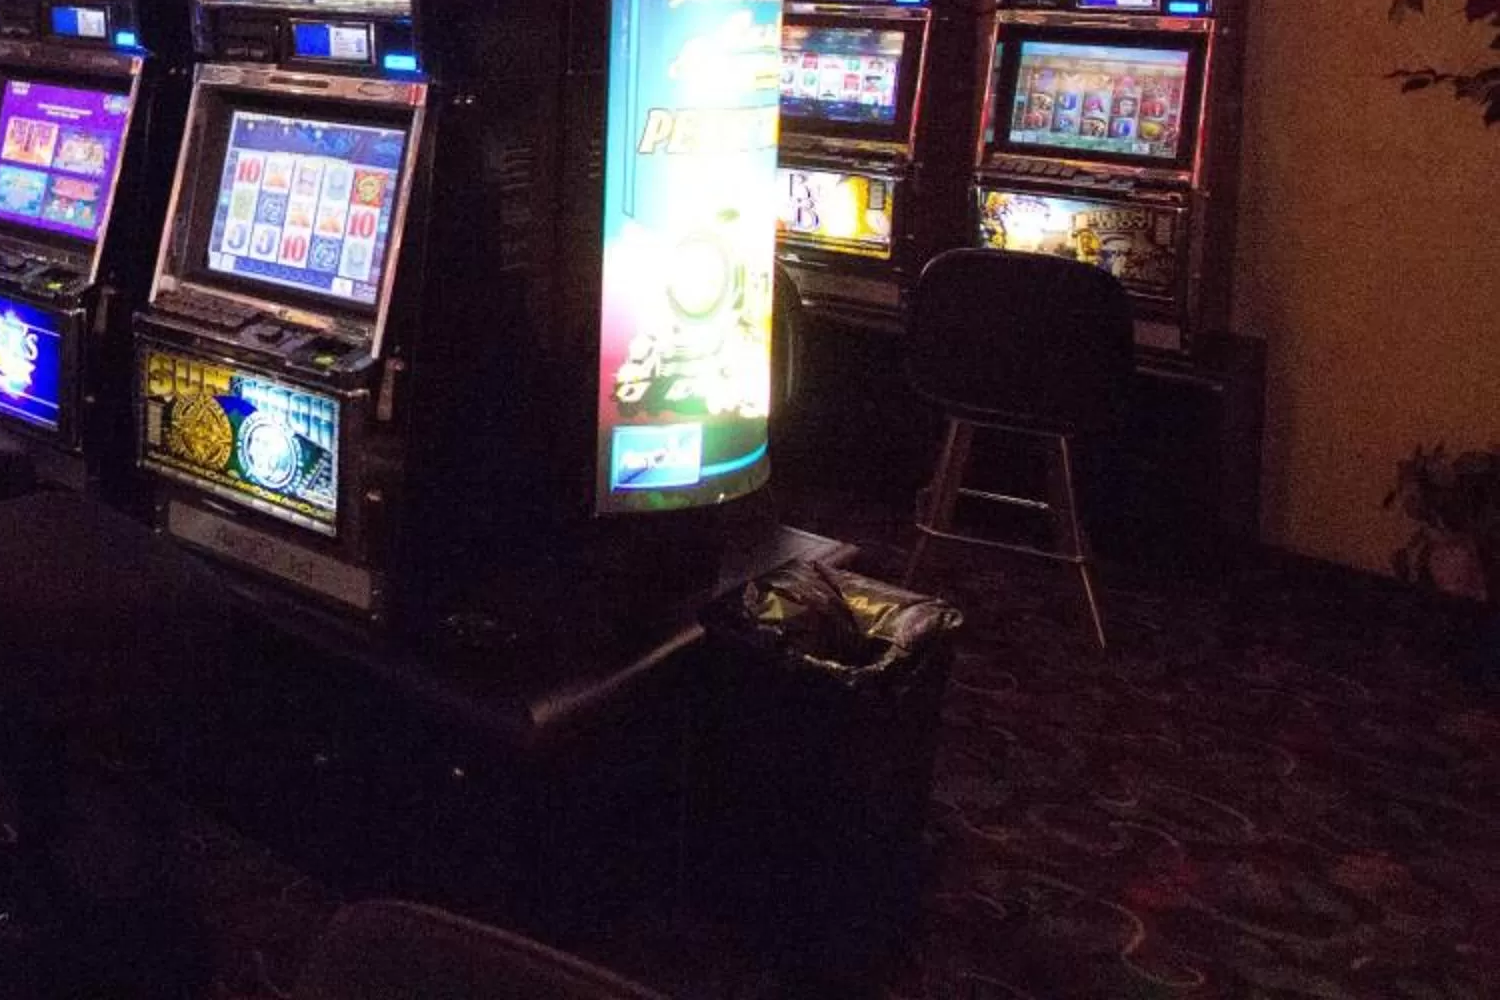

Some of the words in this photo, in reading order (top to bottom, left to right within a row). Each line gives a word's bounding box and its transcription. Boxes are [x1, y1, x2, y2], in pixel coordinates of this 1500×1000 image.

[238, 158, 261, 184] 10
[348, 211, 375, 238] 10
[282, 236, 307, 262] 10
